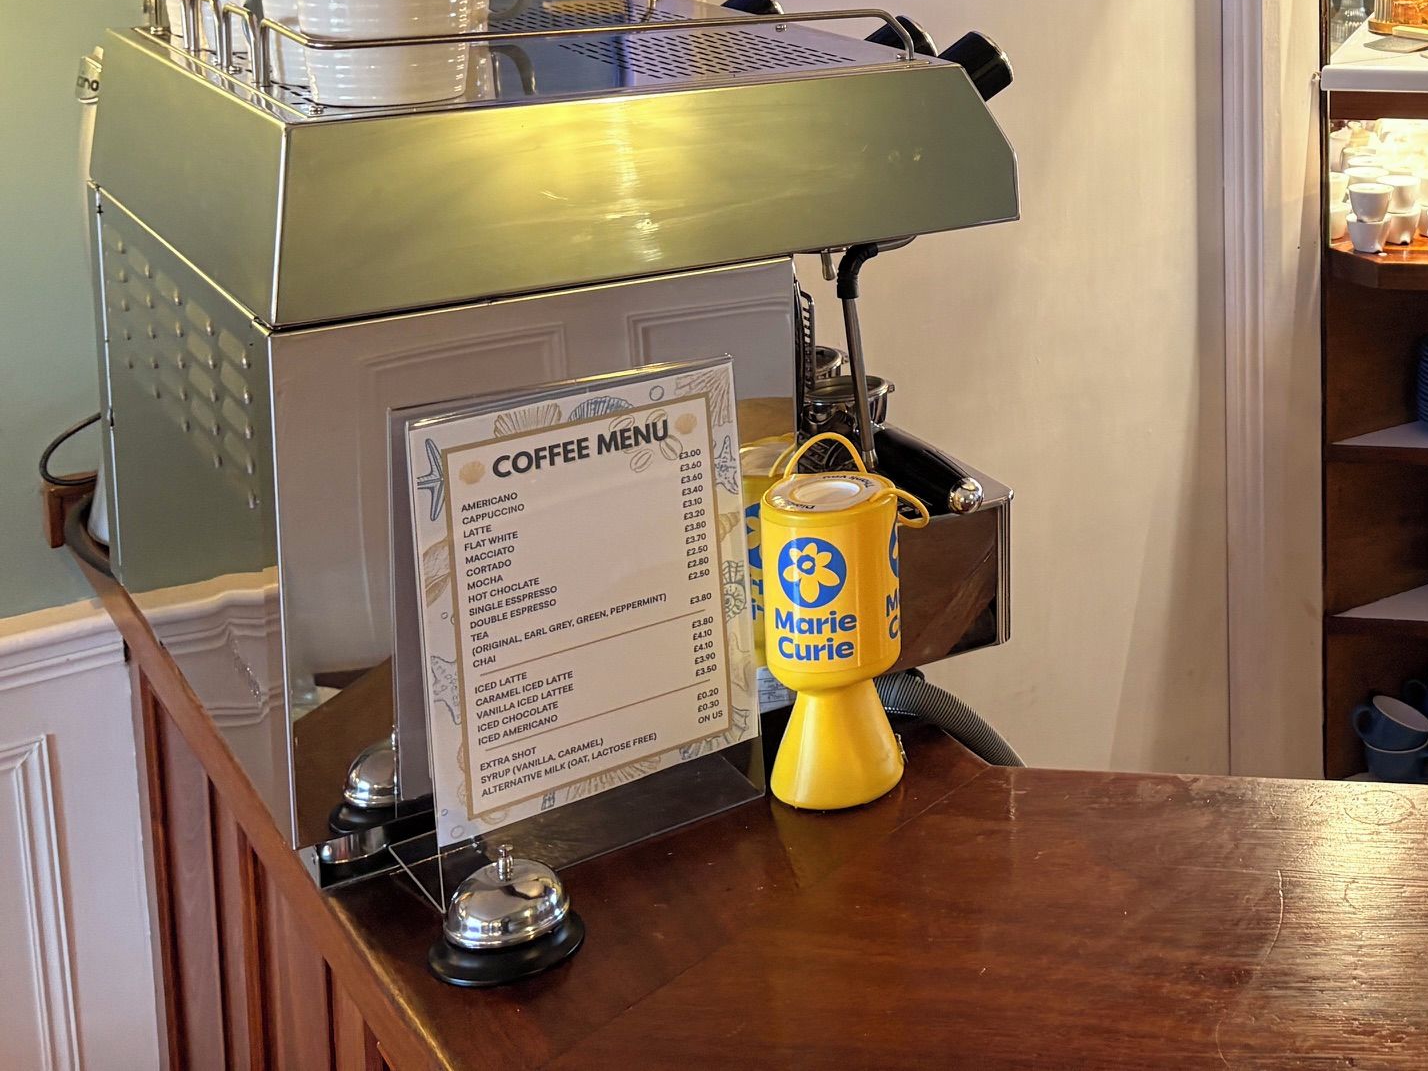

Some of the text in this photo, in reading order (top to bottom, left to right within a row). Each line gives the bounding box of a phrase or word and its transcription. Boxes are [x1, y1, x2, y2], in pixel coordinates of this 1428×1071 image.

[492, 419, 668, 478] COFFEE MENU
[678, 448, 701, 460] £3.00
[679, 460, 702, 472] £3.60
[680, 472, 703, 484] £3.60
[681, 484, 703, 497] £3.40
[461, 491, 518, 512] AMERICANO
[682, 496, 703, 509] £3.10
[461, 503, 525, 525] CAPPUCCINO
[683, 508, 705, 521] £3.20
[463, 524, 492, 538] LATTE
[684, 520, 707, 533] £3.80
[464, 530, 518, 552] FLAT WHITE
[685, 532, 707, 545] £3.70
[465, 544, 515, 564] MACCIATO
[686, 544, 708, 557] £2.50
[465, 558, 512, 577] CORTADO
[687, 556, 709, 569] £2.80
[688, 568, 710, 581] £2.50
[466, 574, 504, 591] MOCHA
[467, 577, 540, 604] HOT CHOCLATE
[468, 585, 557, 616] SINGLE ESSPRESSO
[689, 592, 712, 605] £3.80
[469, 598, 557, 630] DOUBLE ESPRESSO
[691, 615, 714, 629] £3.80
[775, 608, 858, 635] Marie
[470, 630, 489, 642] TEA
[524, 627, 548, 640] EARL
[692, 628, 712, 641] £4.10
[693, 640, 714, 653] £4.10
[778, 636, 854, 661] Curie
[472, 654, 496, 668] CHAI
[694, 651, 716, 665] £3.90
[695, 663, 717, 677] £3.50
[474, 671, 527, 694] ICED LATTE
[475, 670, 573, 707] CARAMEL ICED LATTE
[696, 687, 719, 701] £0.20
[476, 683, 574, 720] VANILLA ICED LATTEE
[697, 699, 720, 713] £0.30
[477, 700, 559, 733] ICED CHOCOLATE
[697, 709, 723, 724] ON US
[478, 714, 558, 746] ICED AMERICANO
[479, 746, 537, 772] EXTRA SHOT
[480, 767, 511, 784] SYRUP
[481, 770, 542, 797] ALTERNATIVE
[544, 761, 566, 776] MILK
[591, 740, 631, 760] LACTOSE
